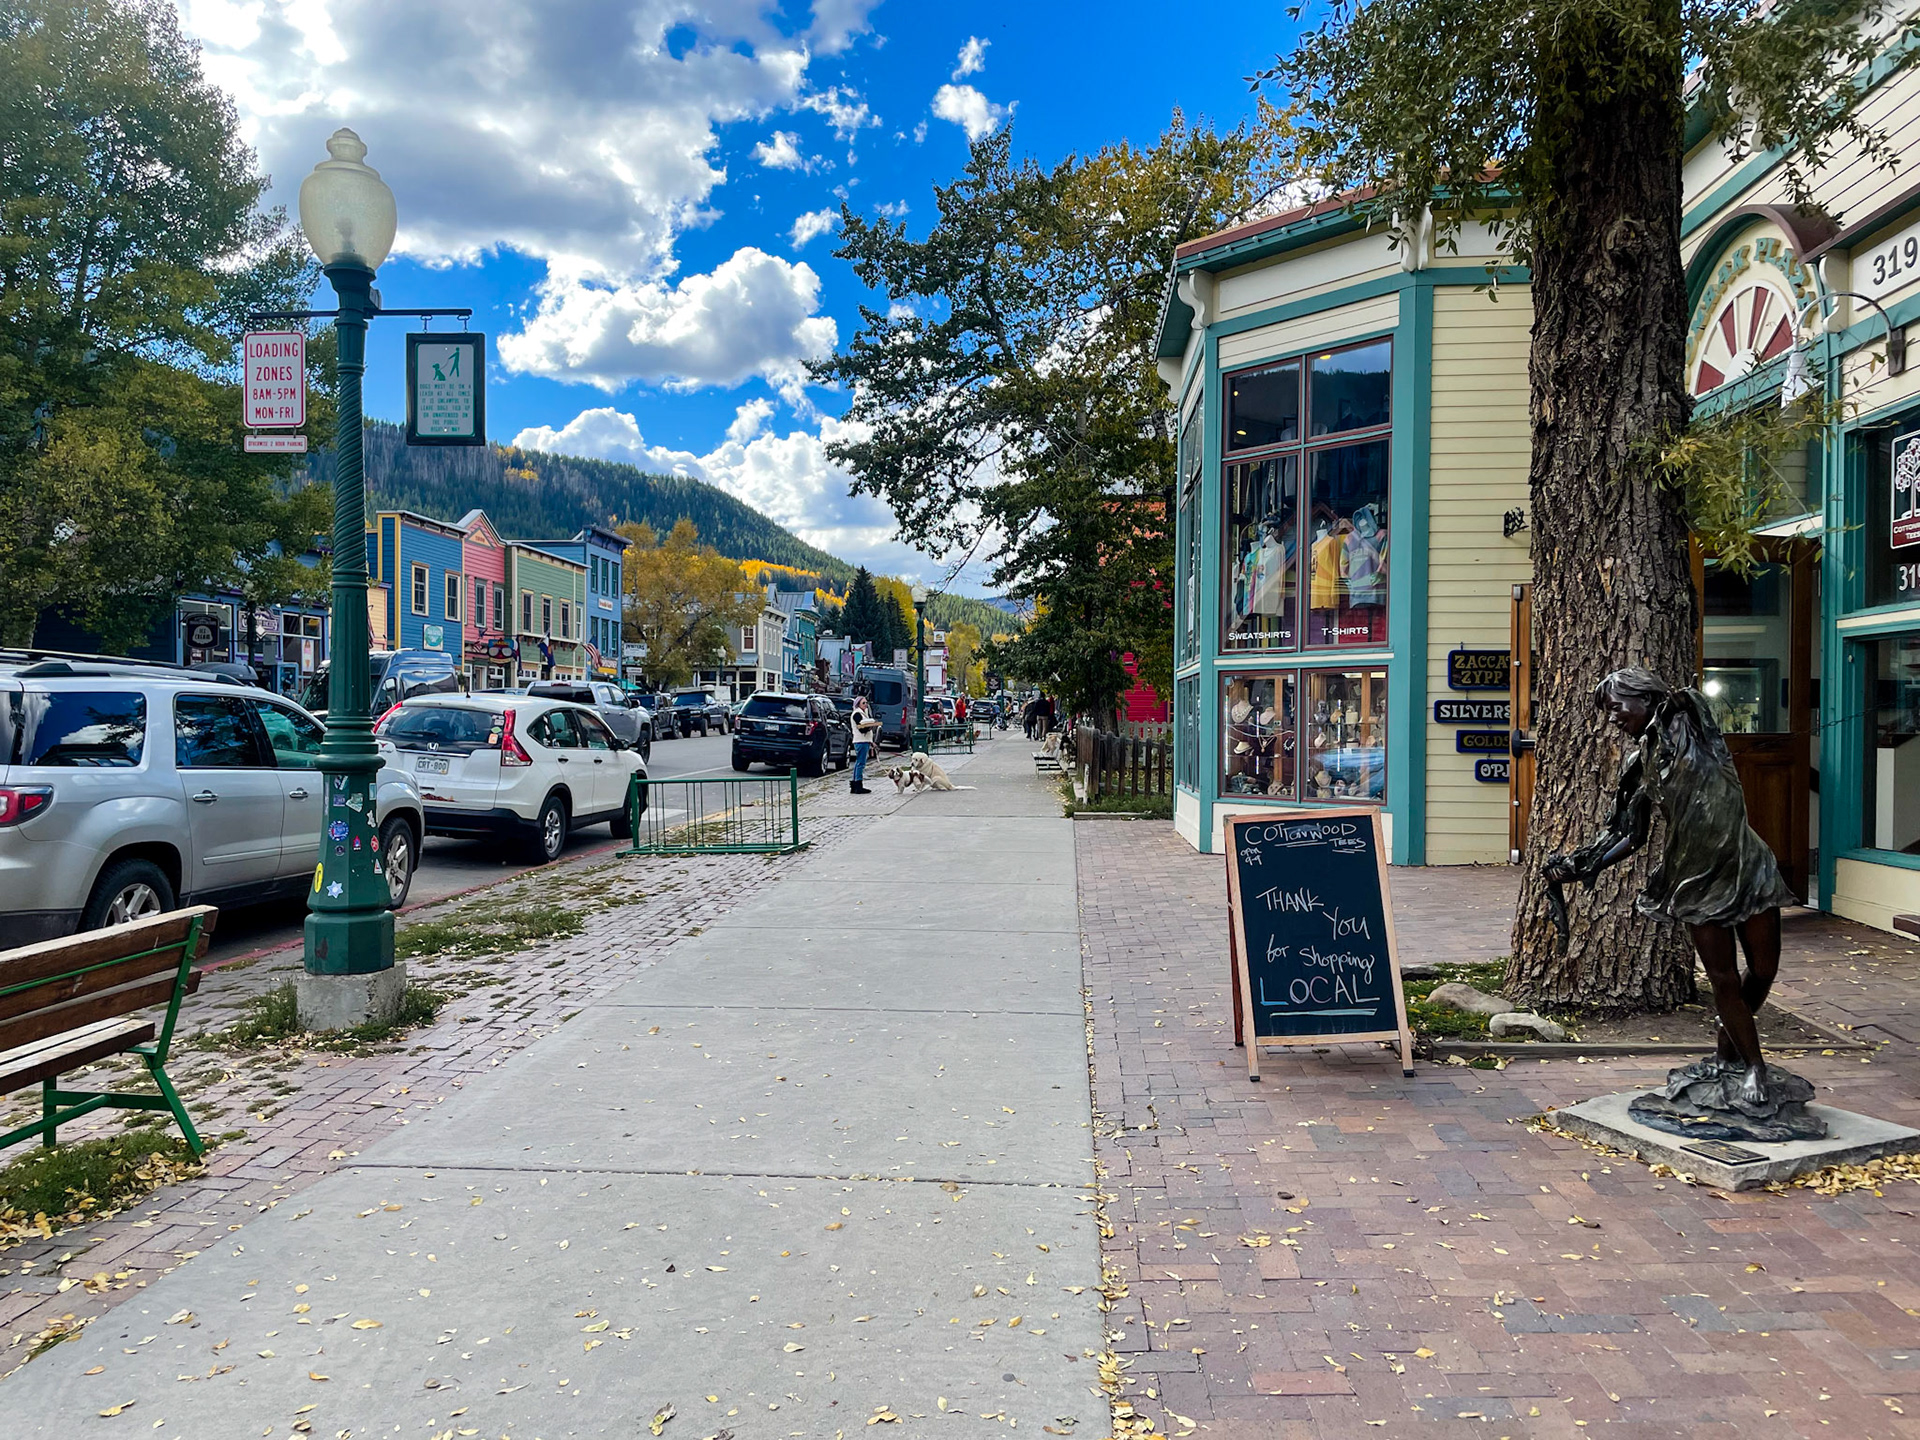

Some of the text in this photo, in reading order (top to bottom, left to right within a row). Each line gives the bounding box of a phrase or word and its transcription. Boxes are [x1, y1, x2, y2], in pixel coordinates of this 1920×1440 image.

[1872, 236, 1918, 286] 319
[1753, 237, 1819, 329] PLAZA
[249, 342, 299, 358] LOADING
[256, 366, 293, 382] ZONES
[253, 387, 297, 401] 8AM-5PM
[255, 406, 294, 419] MON-FRI
[1228, 630, 1291, 641] SWEATSHIRTS
[1321, 626, 1369, 636] T-SHIRTS
[1454, 655, 1510, 669] ZACCA
[1440, 704, 1510, 718] SILVERS
[1463, 734, 1509, 746] GOLDS
[1244, 822, 1357, 845] COTTONWOOD
[1328, 837, 1367, 849] TEES
[1255, 886, 1325, 913] THANK
[1266, 934, 1375, 984] for Shopping
[1259, 974, 1381, 1006] LOCAL
